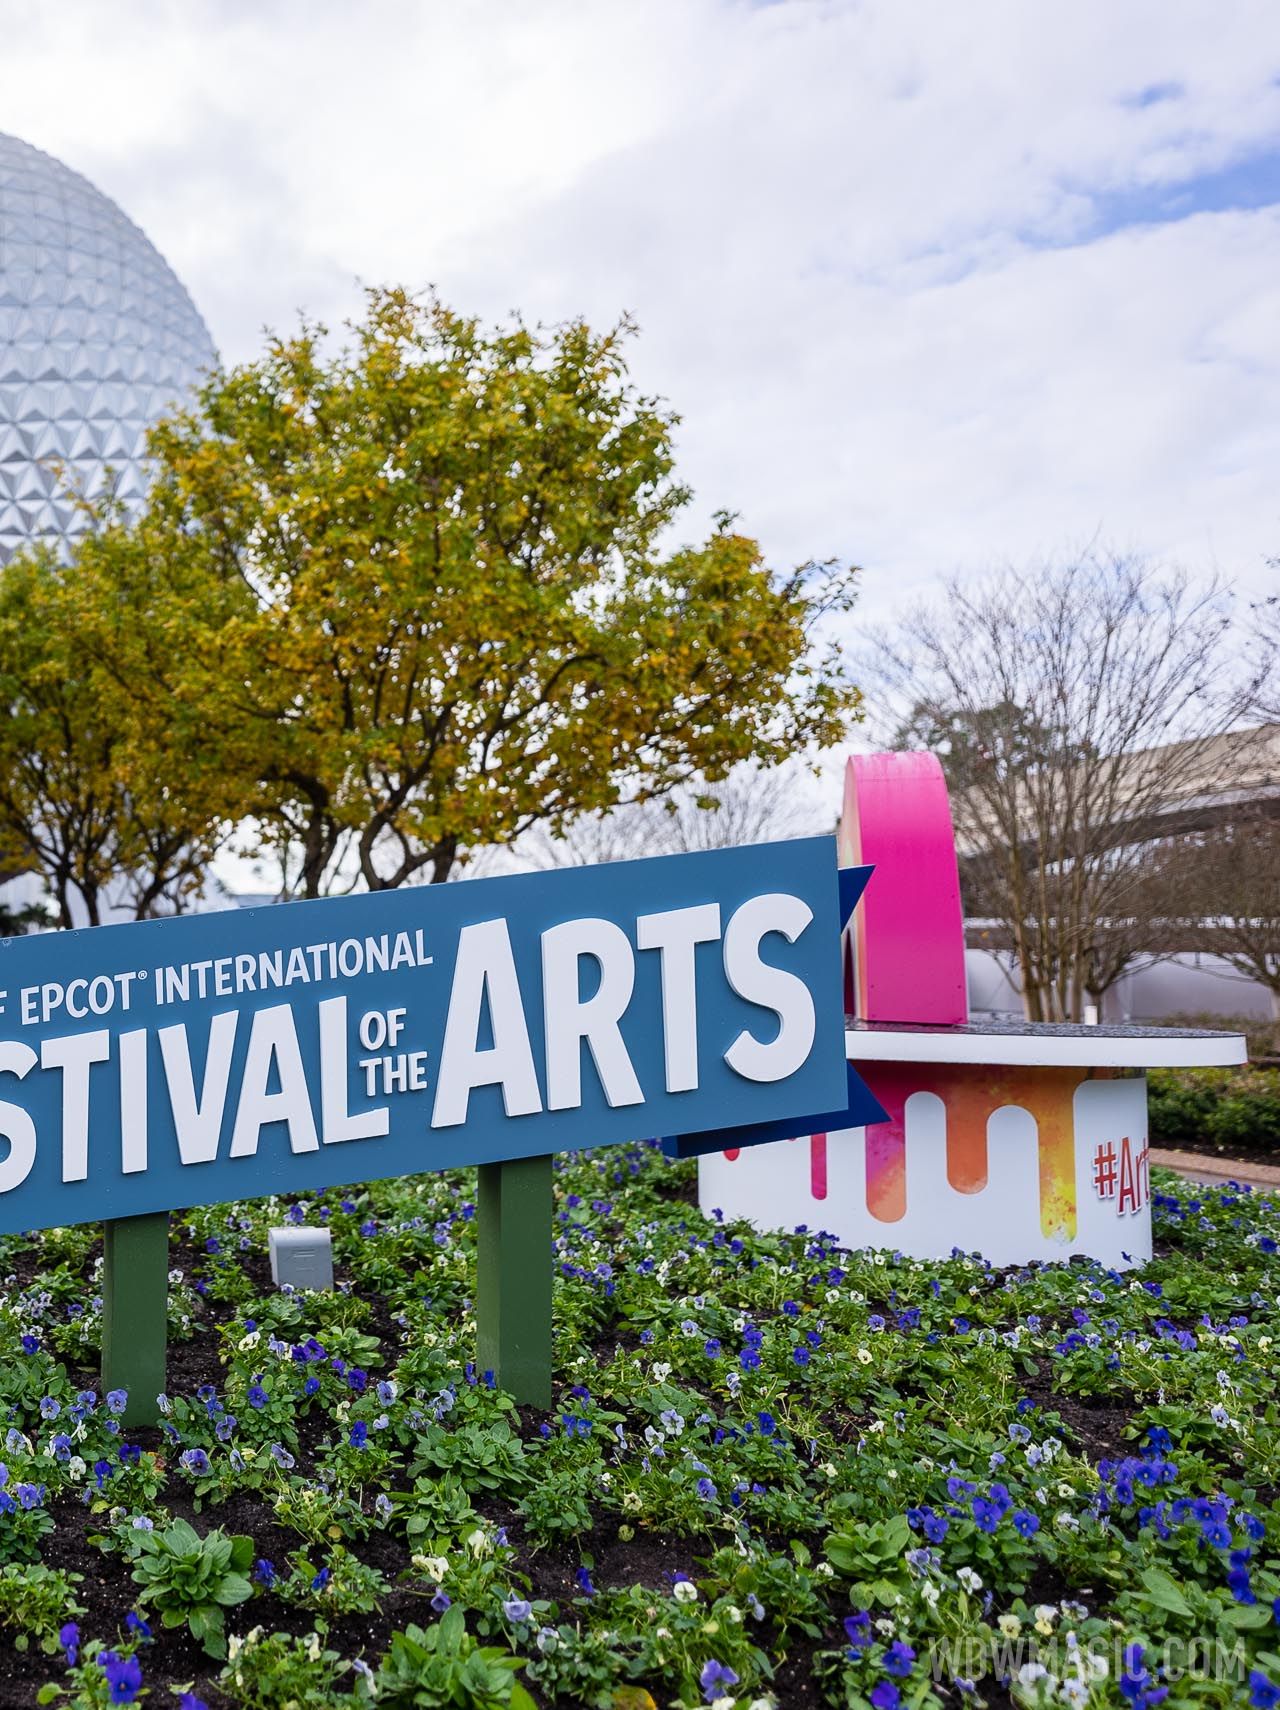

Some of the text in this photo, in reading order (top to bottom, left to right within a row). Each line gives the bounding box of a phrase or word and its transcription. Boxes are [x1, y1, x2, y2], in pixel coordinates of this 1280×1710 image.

[154, 929, 434, 1005] INTERNATIONAL
[359, 1007, 408, 1051] OF
[430, 893, 817, 1129] ARTS
[358, 1050, 428, 1097] THE
